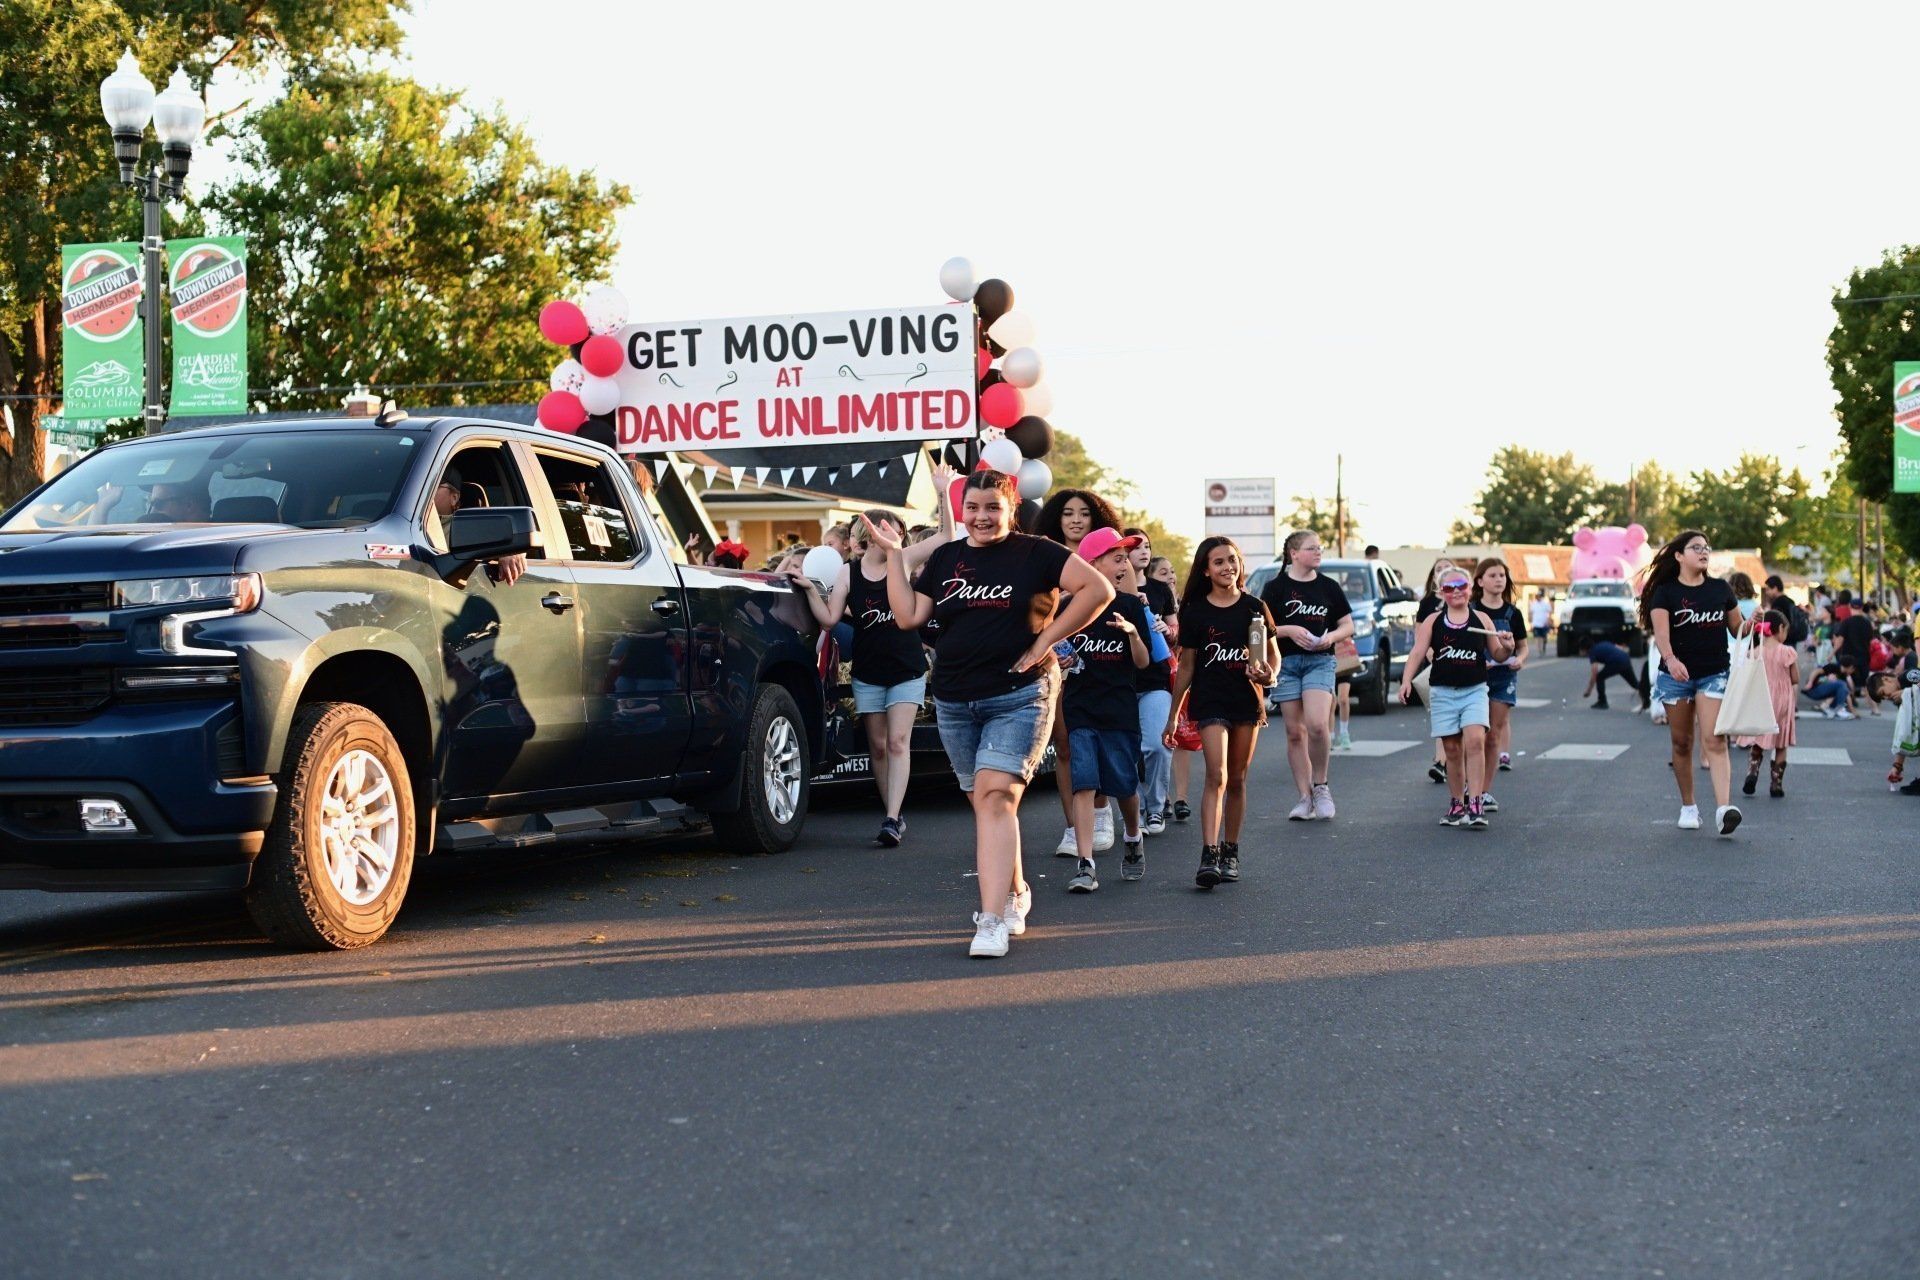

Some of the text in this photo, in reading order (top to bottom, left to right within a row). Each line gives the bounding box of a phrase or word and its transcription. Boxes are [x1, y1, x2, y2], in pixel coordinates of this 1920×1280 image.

[68, 271, 130, 308] DOWNTOWN
[176, 264, 235, 304] DOWNTOWN
[72, 287, 136, 320] HERMISTON
[182, 281, 240, 317] HERMISTON
[628, 313, 959, 369] GET MOO-VING
[179, 352, 238, 371] GUARDIAN
[776, 367, 803, 388] AT
[67, 386, 139, 398] COLUMBIA
[67, 399, 101, 409] Dental
[46, 417, 57, 428] SW
[77, 419, 90, 430] NW
[617, 389, 971, 445] DANCE UNLIMITED
[1898, 457, 1920, 469] Bru
[937, 579, 1013, 605] Dance
[967, 599, 1010, 608] Unlimited
[1285, 600, 1328, 618] Dance
[861, 609, 895, 629] Dan
[1073, 634, 1124, 653] Dance
[1436, 646, 1477, 660] Dance
[1204, 643, 1249, 667] Danc
[832, 758, 870, 773] HWEST
